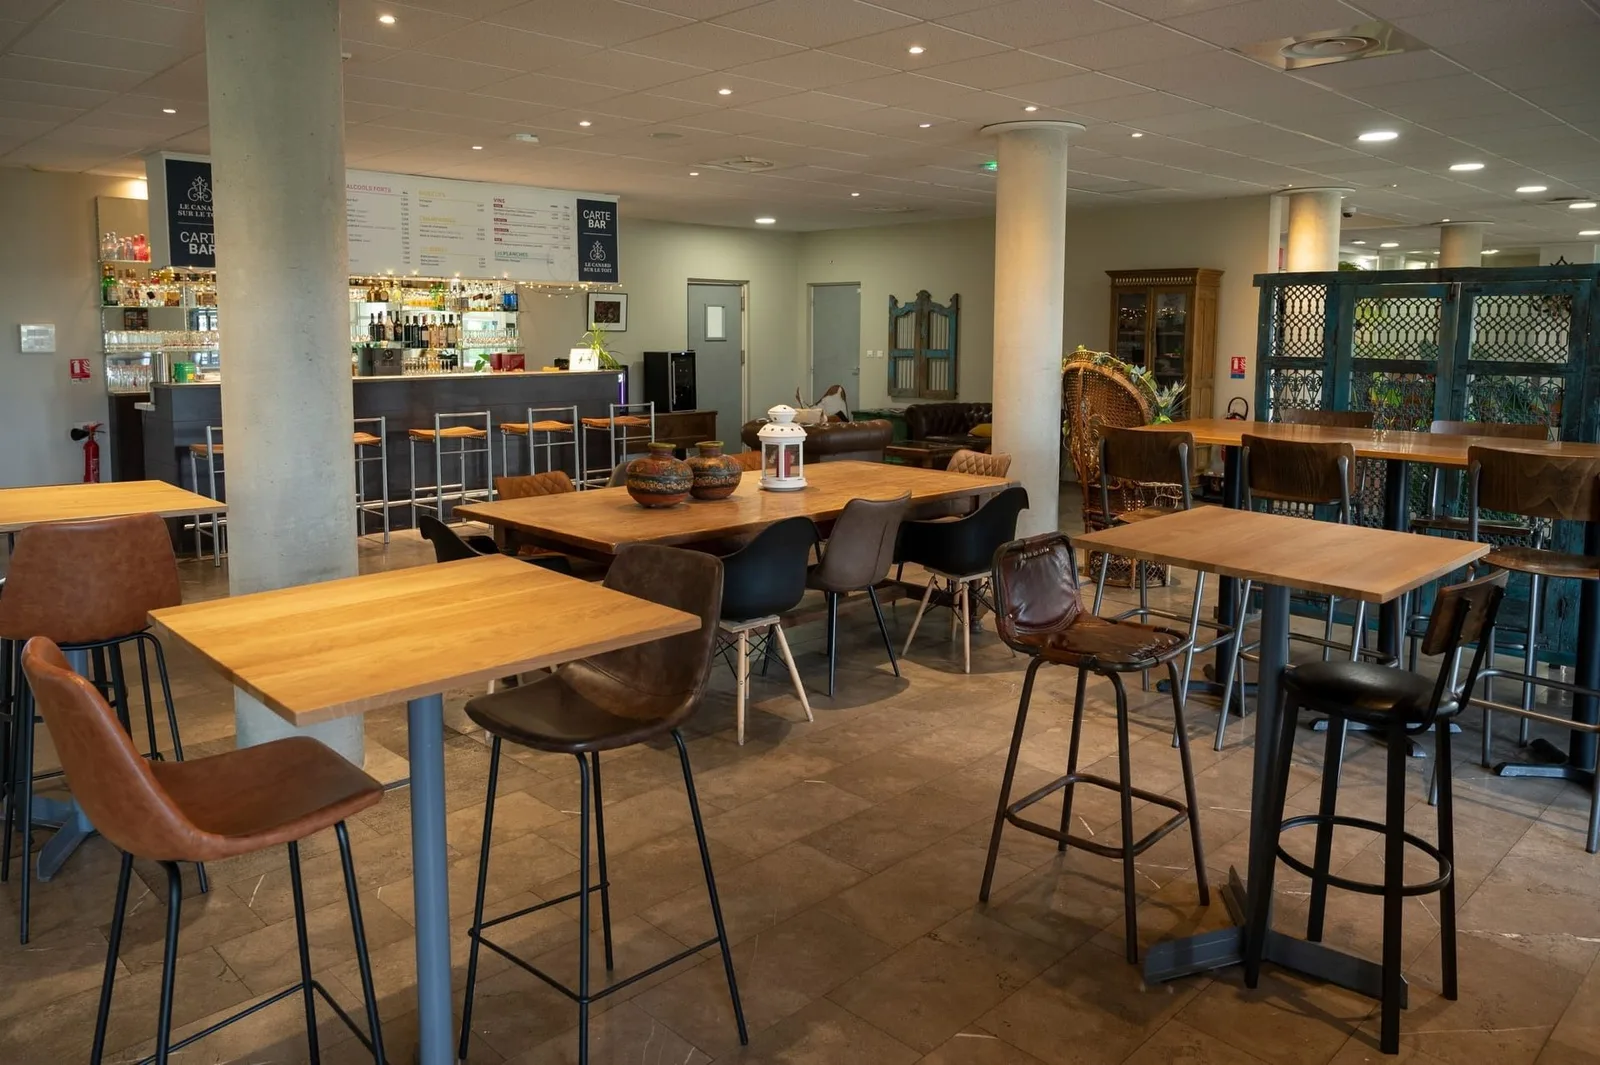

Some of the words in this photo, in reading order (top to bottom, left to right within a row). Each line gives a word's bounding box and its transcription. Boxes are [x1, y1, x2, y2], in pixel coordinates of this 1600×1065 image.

[190, 204, 213, 212] CANA
[583, 209, 611, 221] CARTE
[588, 219, 606, 229] BAR
[180, 231, 215, 244] CART
